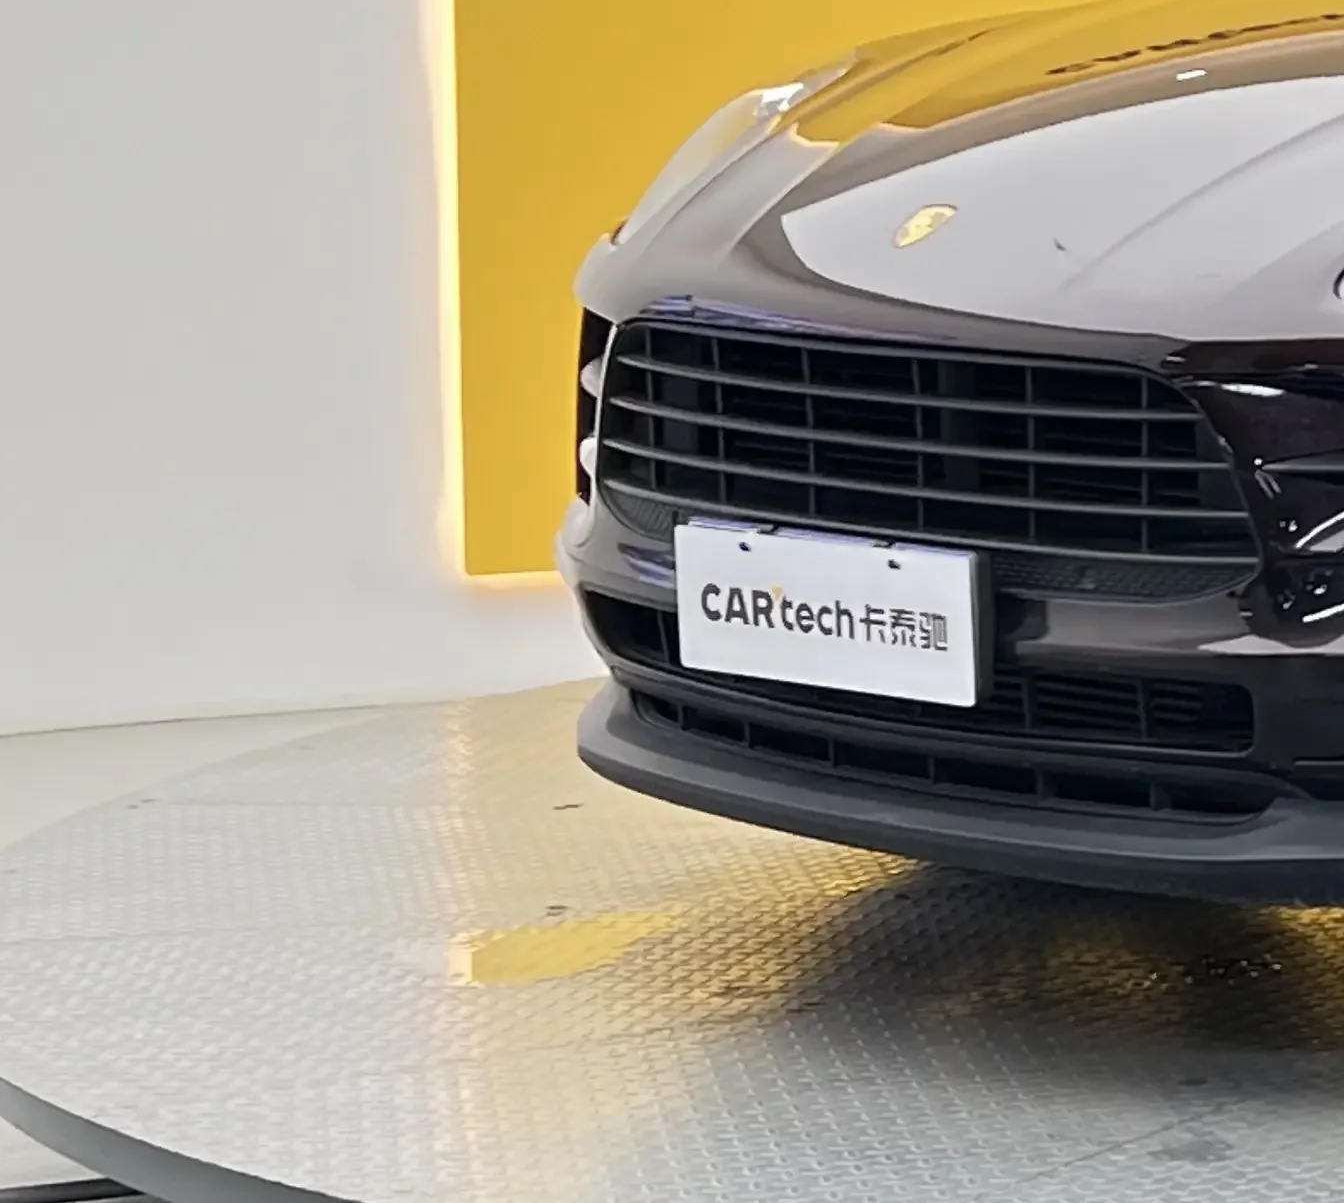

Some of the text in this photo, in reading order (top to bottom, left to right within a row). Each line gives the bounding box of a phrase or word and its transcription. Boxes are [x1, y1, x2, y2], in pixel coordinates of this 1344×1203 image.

[701, 581, 949, 653] CARtech 卡泰驰
